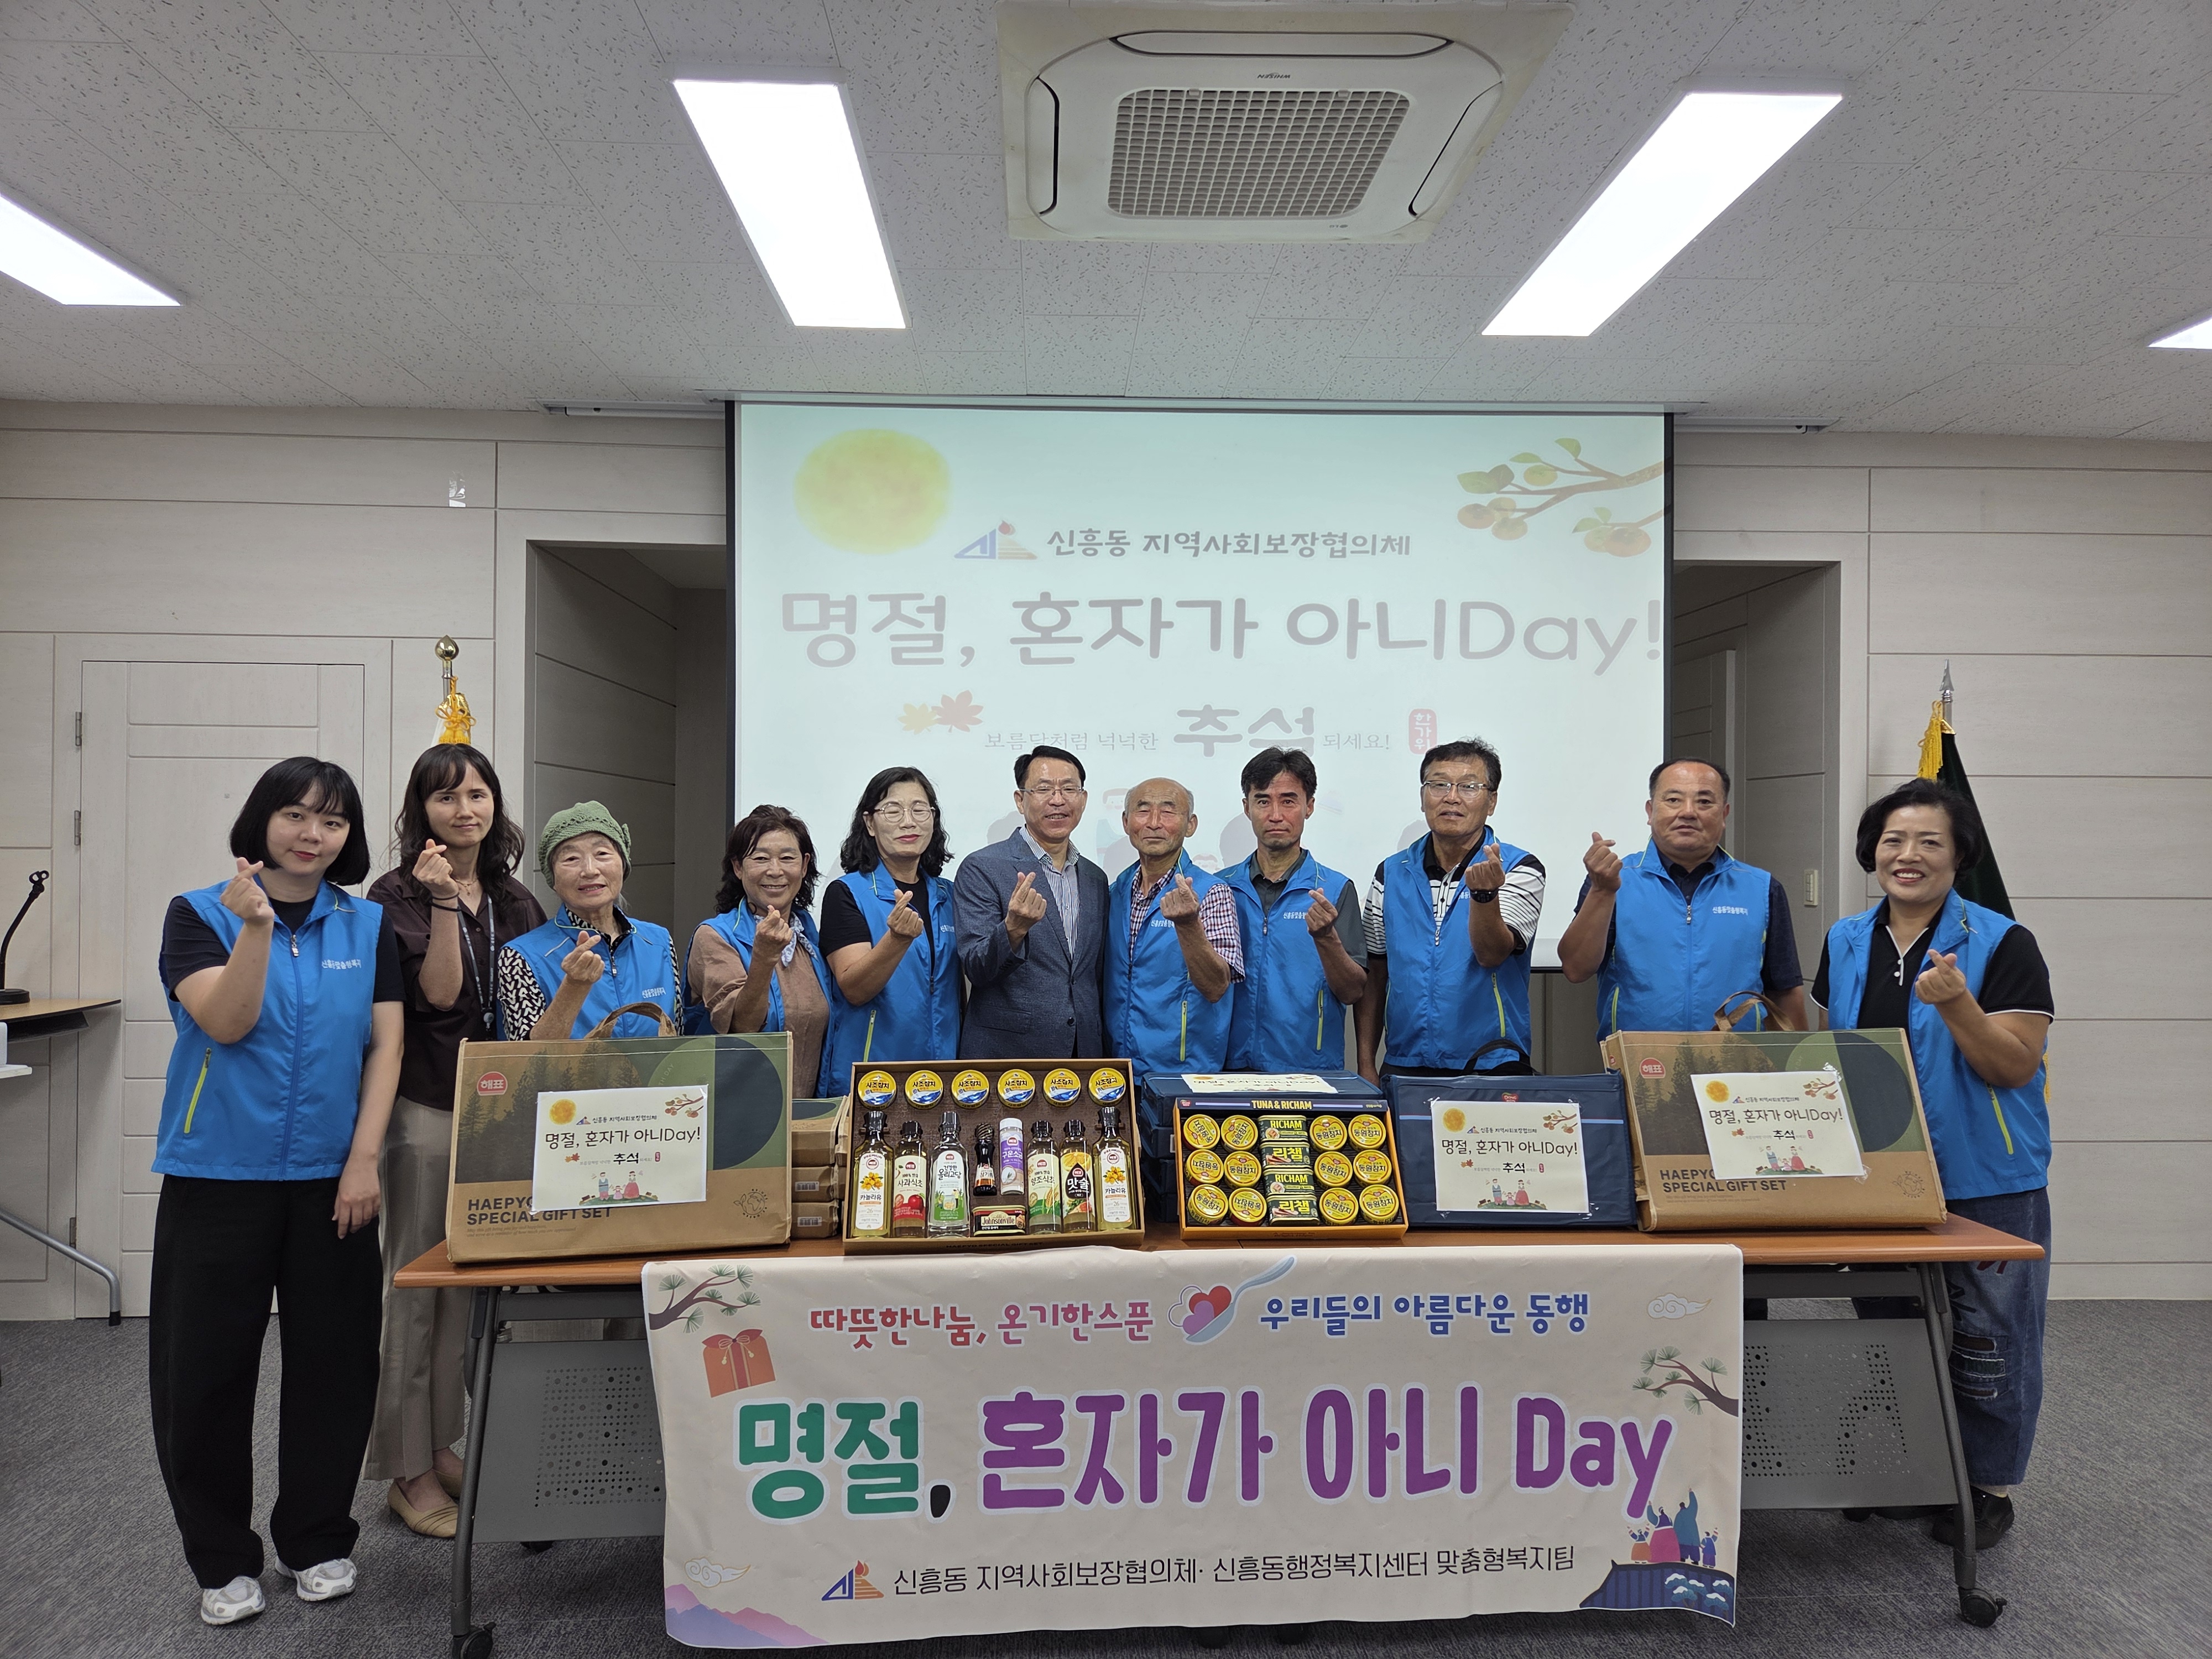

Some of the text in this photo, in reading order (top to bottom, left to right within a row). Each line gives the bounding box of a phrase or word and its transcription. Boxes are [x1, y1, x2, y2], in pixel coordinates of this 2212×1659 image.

[1046, 528, 1411, 559] 신흥동 지역사회보장협의체
[782, 591, 1661, 677] 명절, 혼자가 아니Day!
[984, 704, 1390, 758] 보름달처럼 넉넉한 추석 되세요!
[1413, 712, 1432, 750] 한가위
[1642, 1065, 1663, 1073] 해표
[480, 1079, 504, 1090] 해표
[1709, 1108, 1844, 1125] 명절, 혼자가 아니Day!
[1270, 1120, 1303, 1129] RICHAM
[545, 1126, 701, 1150] 명절, 혼자가 아니Day!
[1772, 1129, 1796, 1140] 추석
[1272, 1147, 1303, 1160] 리챔
[1442, 1139, 1578, 1157] 명절, 혼자가 아니Day!
[613, 1152, 640, 1165] 추석
[1002, 1150, 1023, 1160] 구운소금
[1503, 1162, 1526, 1173] 추석
[937, 1168, 962, 1181] 올리고당
[1031, 1175, 1055, 1186] 양조식초
[1275, 1174, 1308, 1183] RICHAM
[897, 1178, 923, 1188] 사과식초
[1067, 1177, 1090, 1191] 맛술
[1662, 1180, 1787, 1193] SPECIAL GIFT SET
[1279, 1200, 1311, 1213] 리챔
[467, 1207, 611, 1225] SPECIAL GIFT SET
[982, 1216, 1015, 1225] Johnsonville
[811, 1293, 1588, 1349] 따뜻한나눔, 온기한스푼 우리들의 아름다운 동행
[738, 1386, 1673, 1520] 명절, 혼자가 아니 Day
[894, 1566, 967, 1595] 신흥동
[1213, 1551, 1428, 1583] 신흥동행정복지센터
[1436, 1545, 1575, 1576] 맞춤형복지팀
